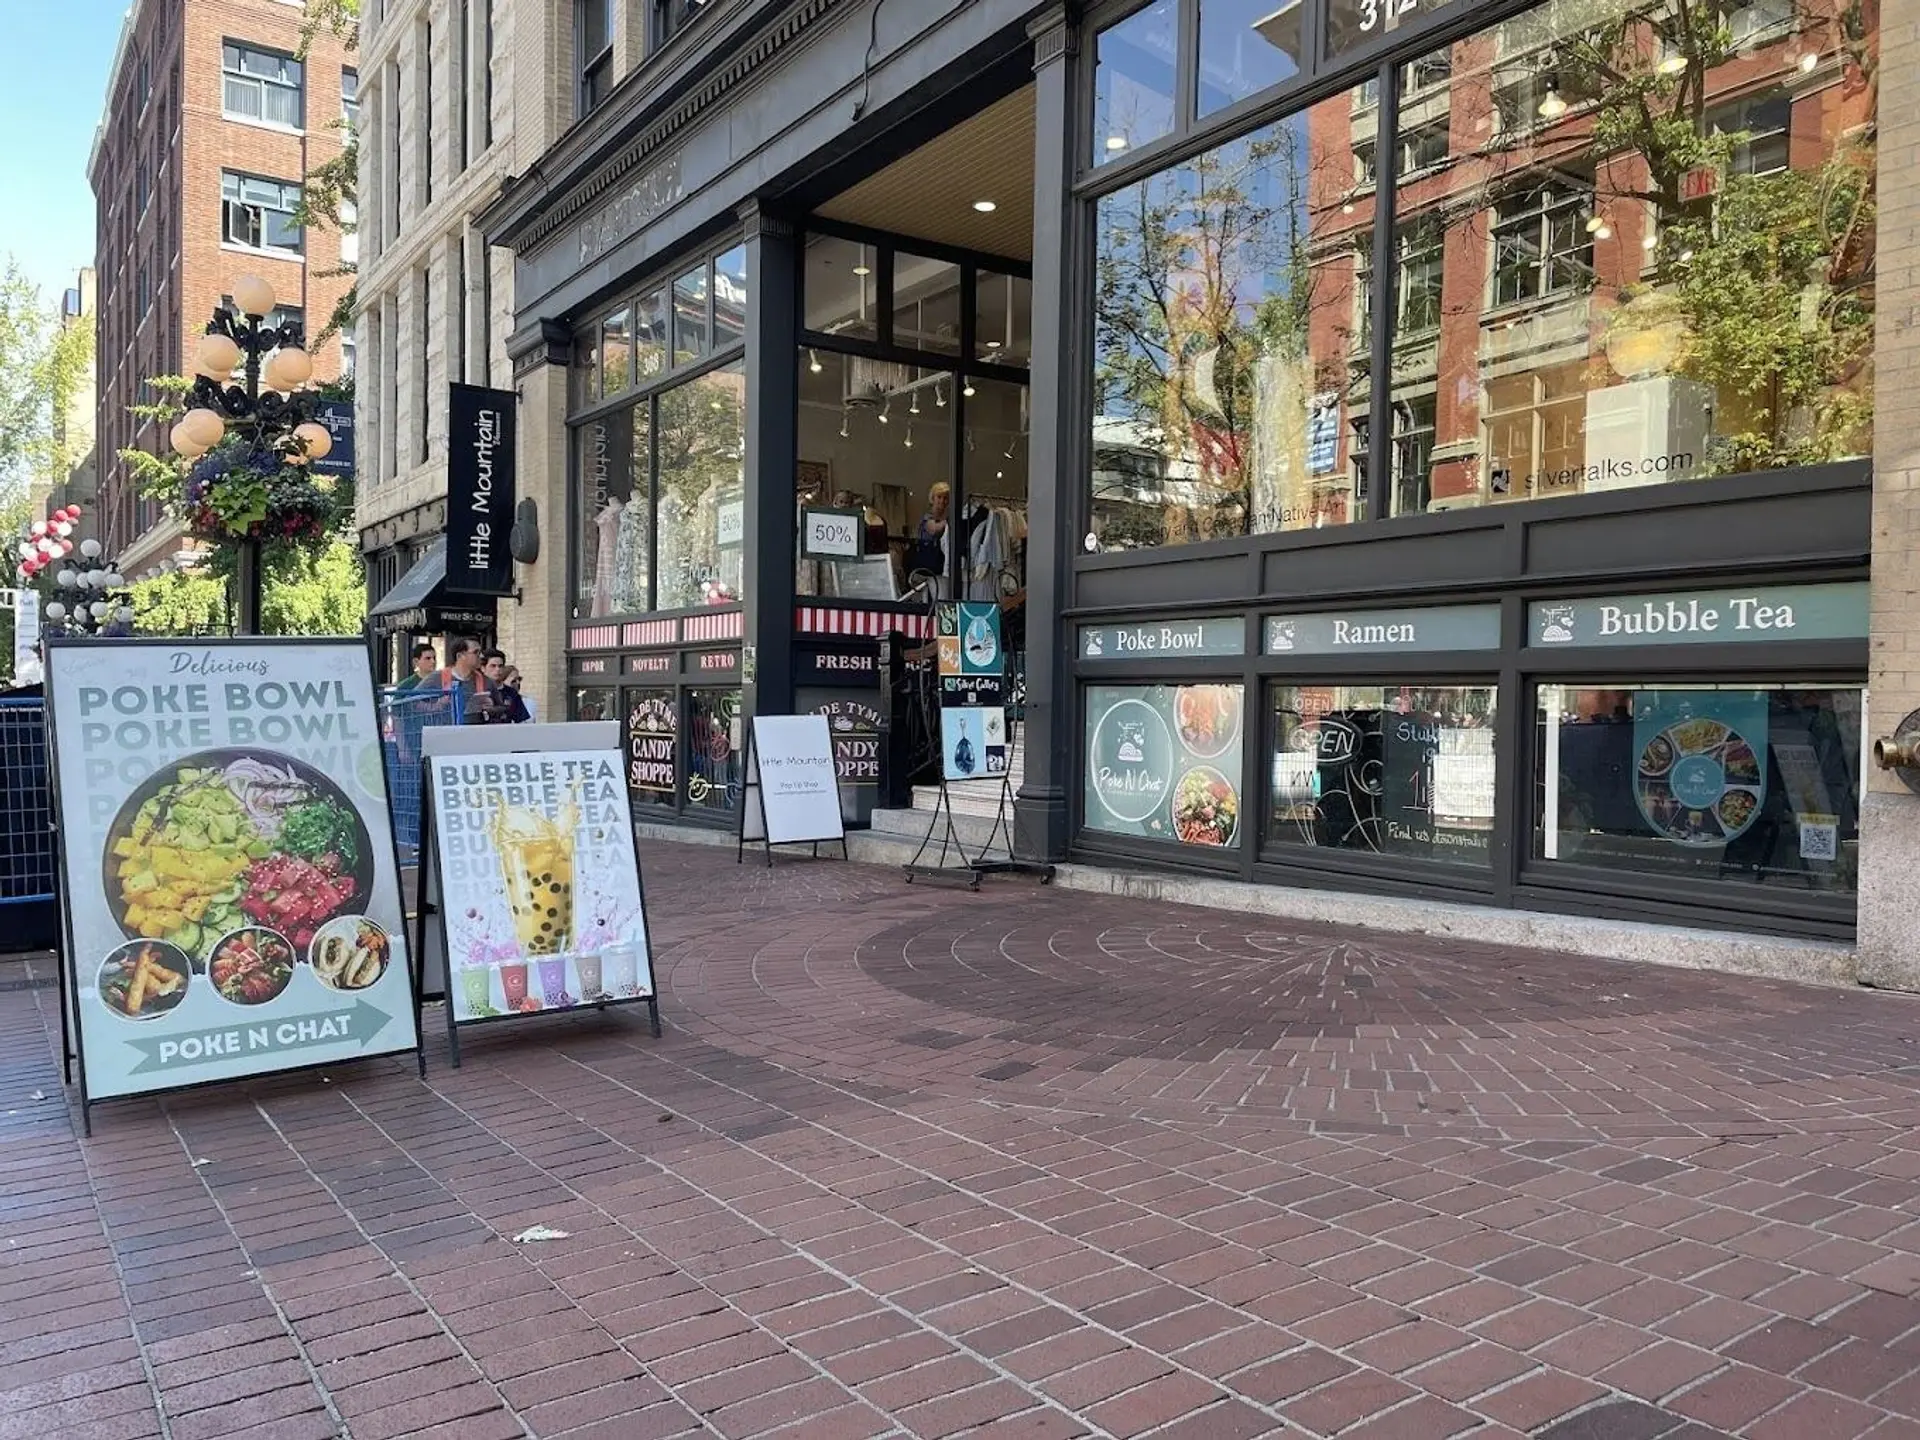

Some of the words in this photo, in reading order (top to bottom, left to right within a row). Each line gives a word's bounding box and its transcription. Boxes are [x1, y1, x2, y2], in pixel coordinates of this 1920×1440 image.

[1360, 0, 1417, 31] 31
[472, 409, 494, 514] Mountain
[1524, 451, 1693, 490] silvertalks.com
[1272, 502, 1318, 522] Native
[1323, 498, 1346, 516] Art
[469, 522, 491, 569] little
[815, 524, 852, 544] 50%
[1599, 600, 1719, 635] Bubble
[1729, 597, 1796, 631] Tea
[1116, 629, 1155, 651] Poke
[1160, 625, 1204, 649] Bowl
[1333, 619, 1415, 645] Ramen
[169, 651, 269, 676] Delicious
[632, 658, 670, 671] NOVELTY
[701, 653, 735, 669] RETRO
[815, 655, 872, 670] FRESH
[79, 684, 209, 717] POKE
[224, 680, 356, 712] BOWL
[1294, 697, 1330, 711] OPEN
[629, 699, 650, 730] OLDE
[652, 699, 677, 731] TYME
[82, 717, 213, 752] POKE
[228, 713, 360, 745] BOWL
[1290, 729, 1355, 753] OPEN
[632, 738, 673, 760] CANDY
[836, 741, 879, 758] NDY
[440, 762, 555, 787] BUBBLE
[562, 759, 616, 782] TEA
[631, 760, 674, 784] SHOPPE
[1099, 766, 1123, 789] Poke
[1125, 768, 1137, 791] N
[1139, 769, 1164, 792] Chat
[443, 784, 558, 810] BUBBLE
[565, 781, 618, 802] TEA
[1387, 821, 1412, 840] Find
[1415, 829, 1430, 843] us
[159, 1031, 240, 1064] POKE
[249, 1027, 268, 1049] N
[276, 1014, 351, 1045] CHAT
